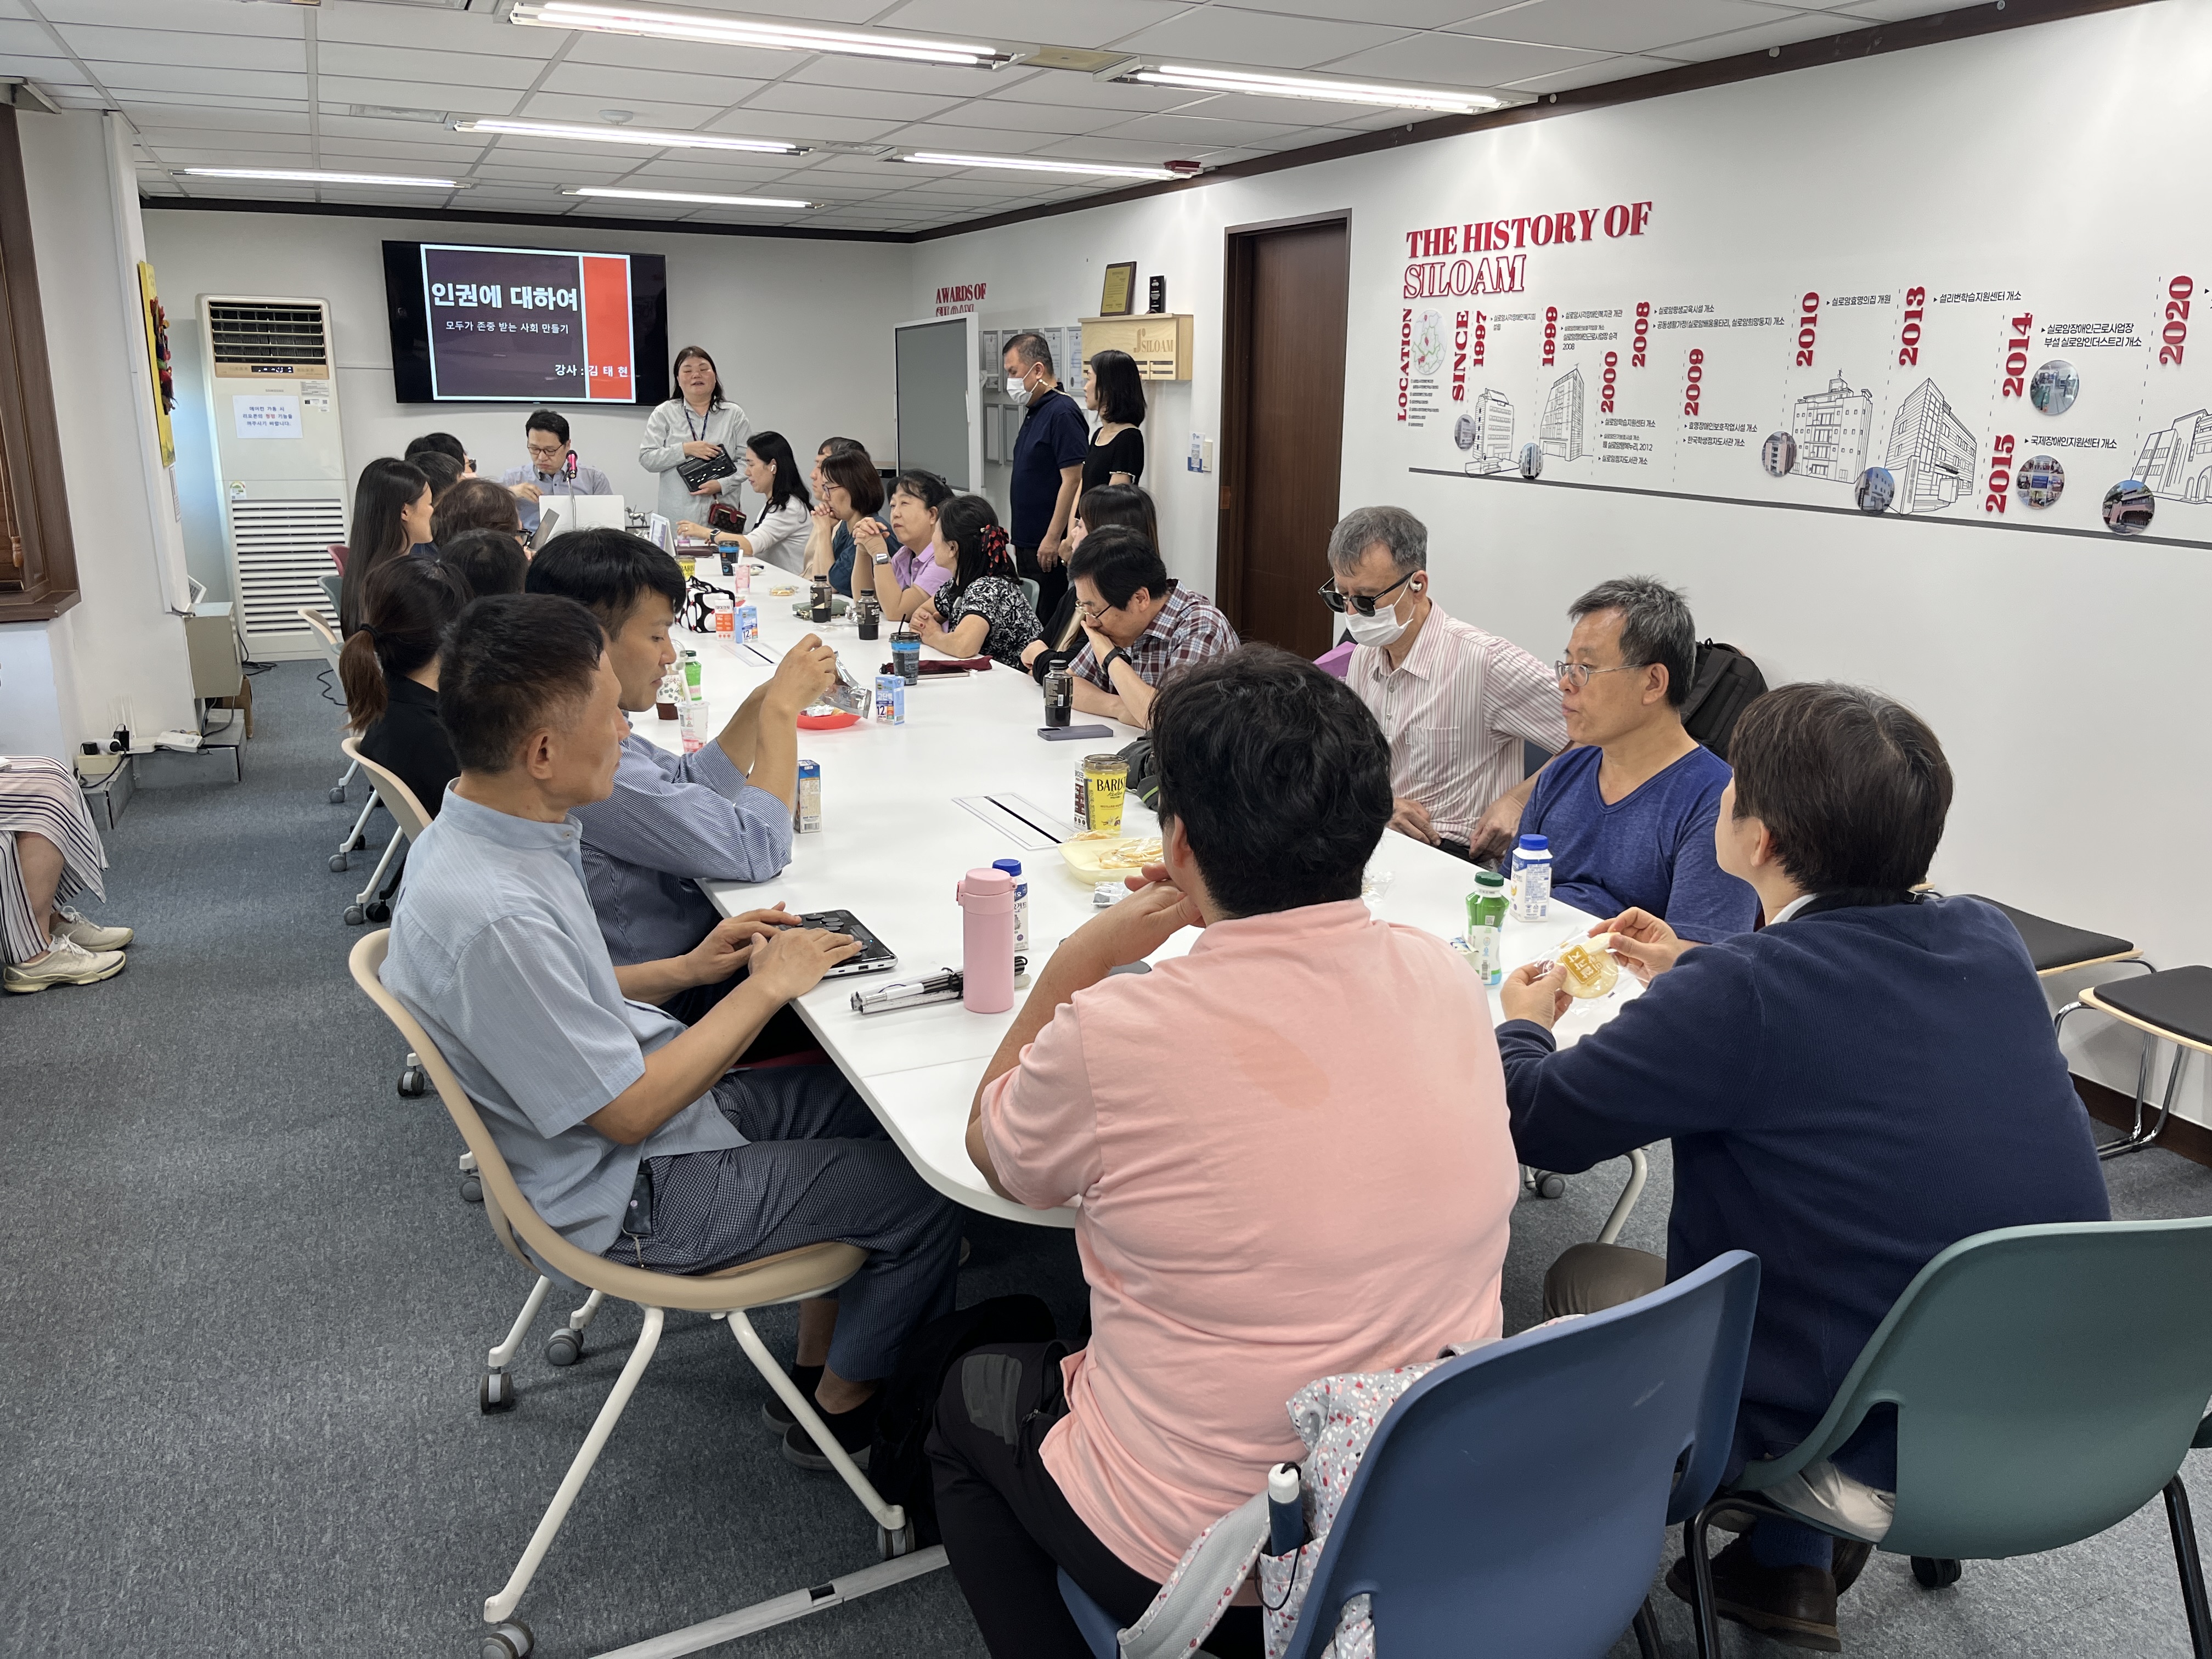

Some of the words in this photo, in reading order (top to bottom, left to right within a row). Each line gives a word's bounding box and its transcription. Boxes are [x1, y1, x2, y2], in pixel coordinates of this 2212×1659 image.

[1406, 227, 1457, 258] THE
[1463, 208, 1600, 253] HISTORY
[1604, 201, 1652, 238] OF
[1404, 254, 1526, 299] SILOAM
[431, 283, 503, 308] 인권에
[510, 286, 578, 312] 대하여
[935, 285, 973, 304] AWARDS
[974, 283, 986, 300] OF
[1831, 295, 1877, 307] 실로암효명의집
[1877, 294, 1891, 304] 개원
[1939, 291, 2006, 303] 설리번학습지원센터
[2006, 291, 2022, 301] 개소
[1704, 304, 1714, 313] 개소
[1773, 317, 1785, 325] 개소
[2159, 275, 2193, 364] 2020
[445, 321, 474, 331] 모두가
[477, 321, 495, 332] 존중
[499, 322, 517, 332] 받는
[520, 323, 538, 333] 사회
[541, 324, 569, 334] 만들기
[1474, 311, 1487, 367] 1997
[1543, 306, 1558, 366] 1999
[1632, 301, 1650, 368] 2008
[1796, 291, 1819, 367] 2010
[1899, 286, 1926, 366] 2013
[2047, 323, 2134, 335] 실로암장애인근로사업장
[1142, 340, 1173, 353] SILOAM
[1452, 310, 1469, 402] SINCE
[2002, 312, 2033, 397] 2014
[2044, 337, 2061, 347] 부설
[2061, 336, 2125, 347] 실로암인더스트리
[2125, 336, 2142, 347] 개소
[555, 364, 577, 376] 강사
[1397, 308, 1412, 421] LOCATION
[1600, 351, 1618, 414] 2000
[1684, 348, 1703, 416] 2009
[1734, 438, 1745, 447] 개소
[1746, 424, 1758, 432] 개소
[2030, 435, 2100, 448] 국제장애인지원센터
[2100, 439, 2117, 449] 개소
[1985, 434, 2015, 514] 2015
[1567, 951, 1594, 978] 쌀과자
